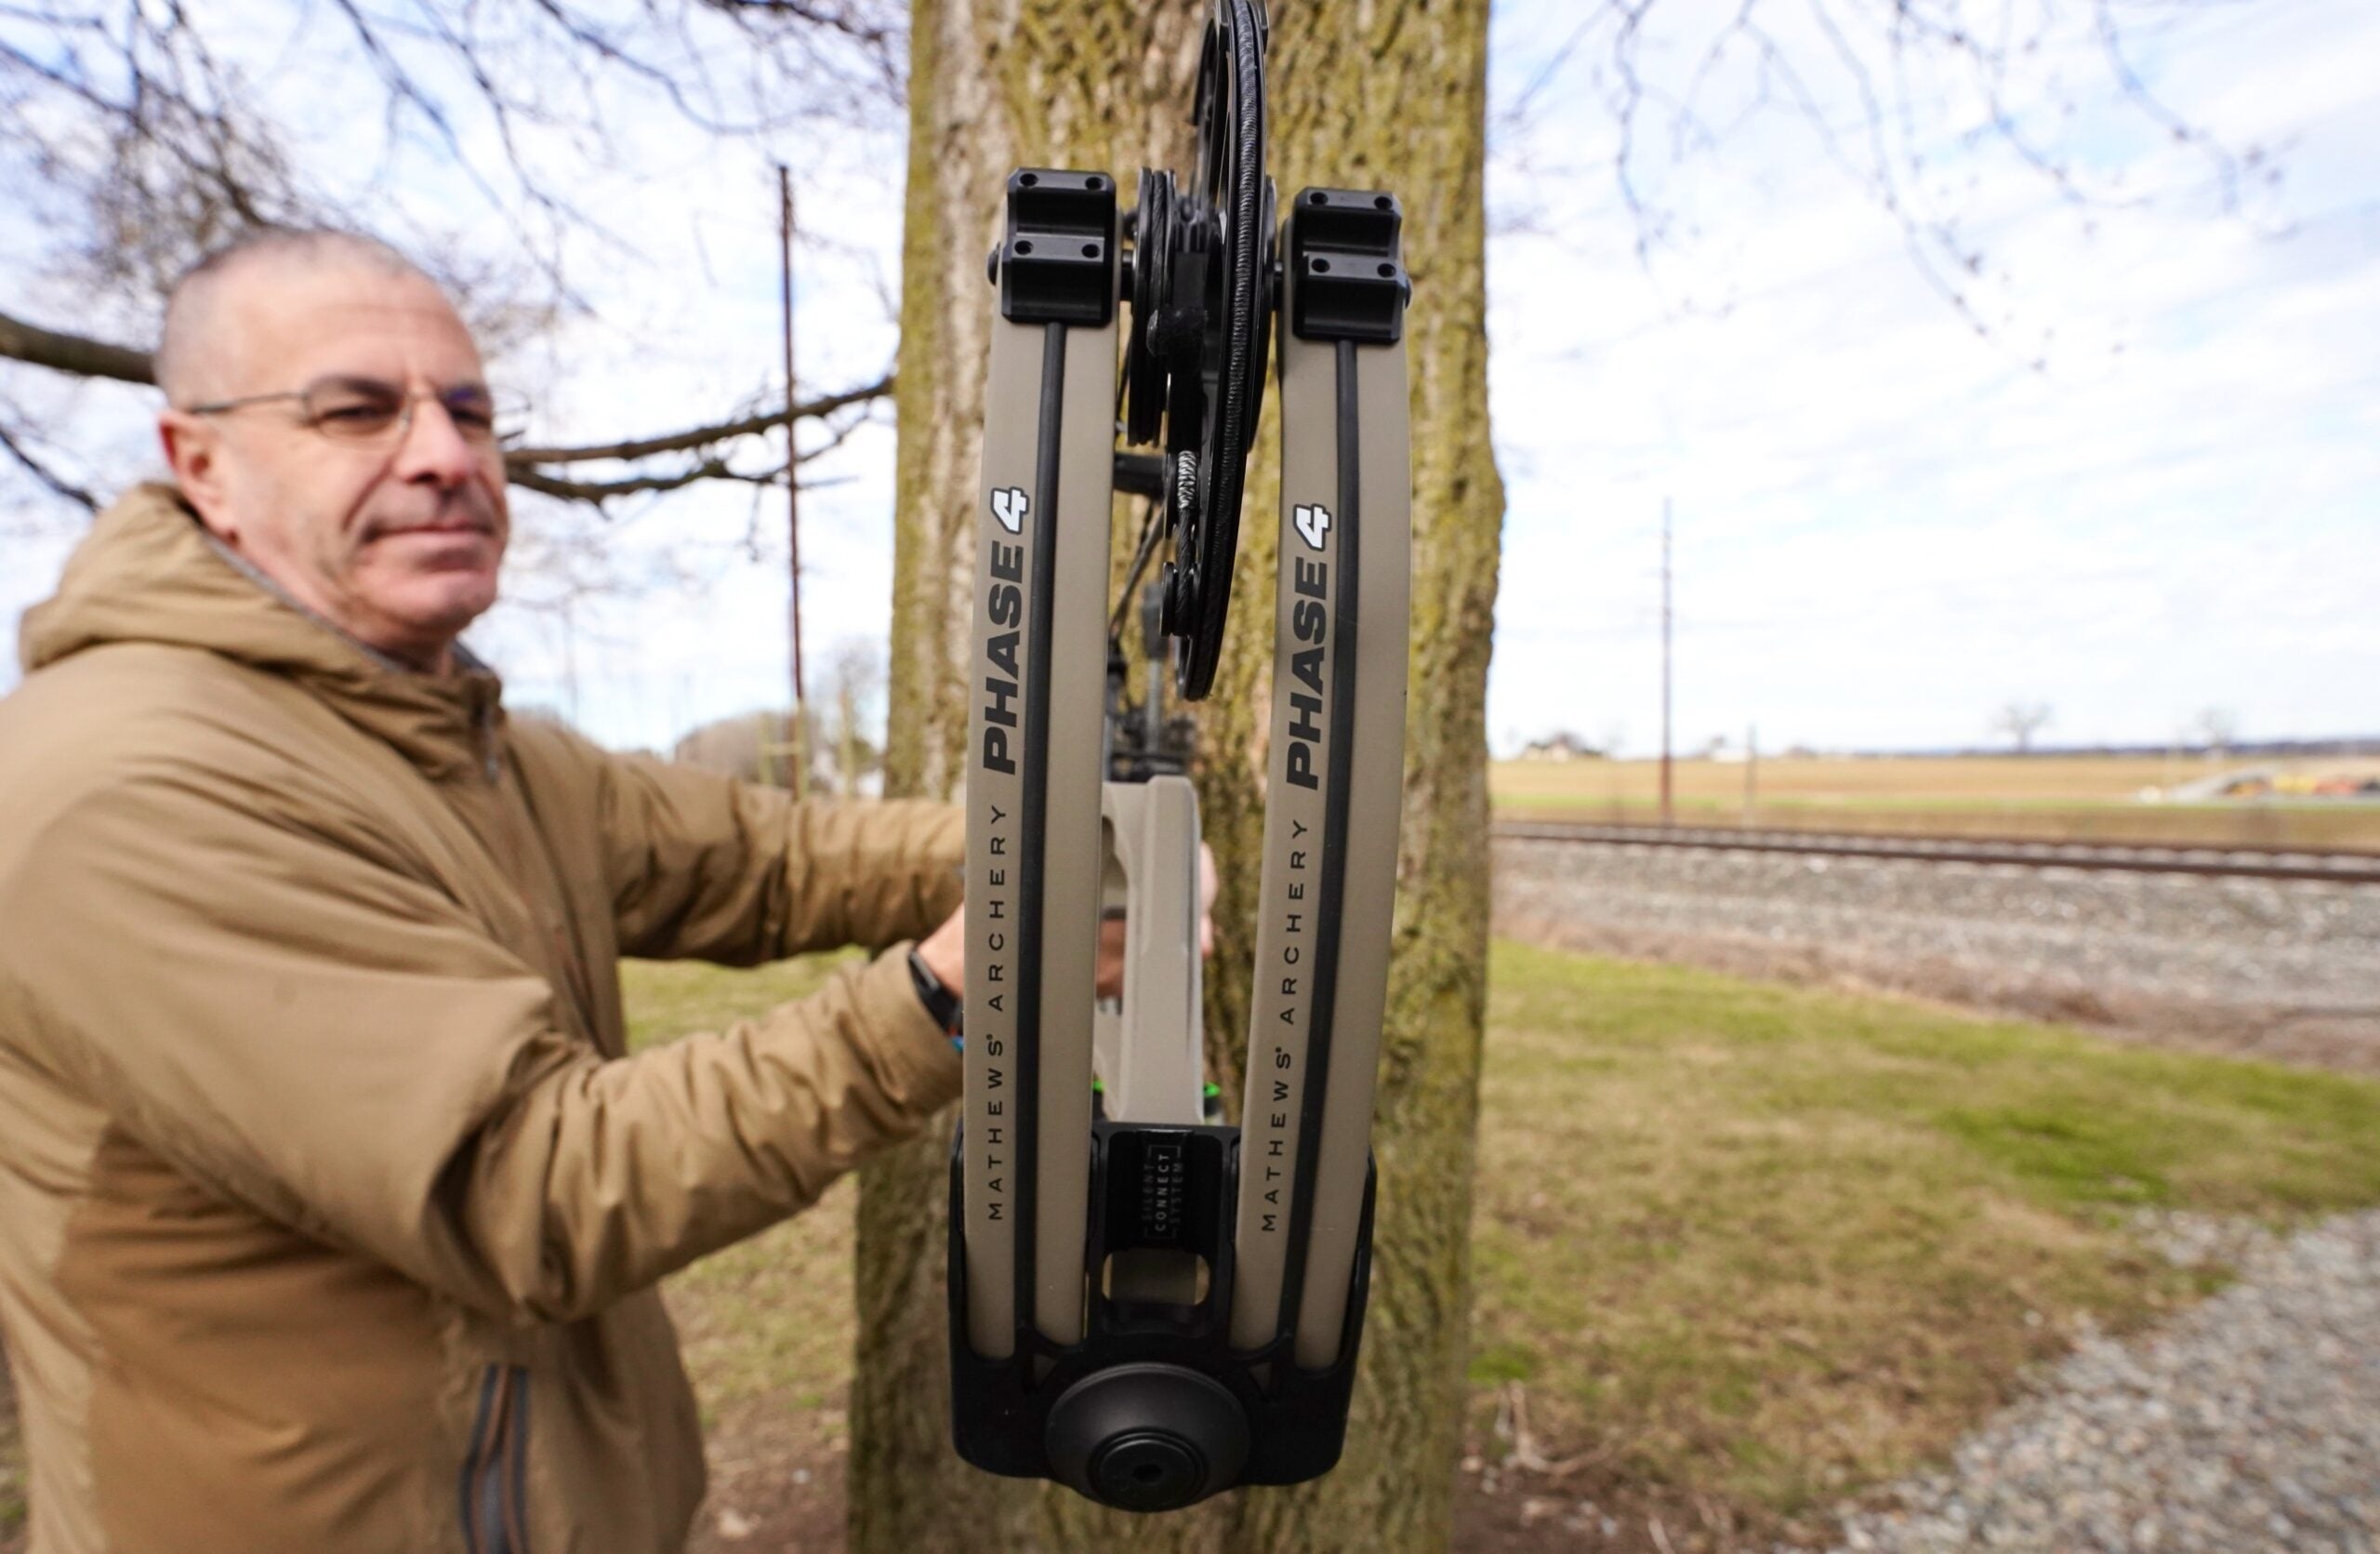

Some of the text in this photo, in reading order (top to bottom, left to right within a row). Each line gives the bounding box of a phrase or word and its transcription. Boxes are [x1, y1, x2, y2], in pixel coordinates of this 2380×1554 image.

[983, 486, 1030, 1220] MATHEWS ARCHERY PHASE 4
[1262, 502, 1332, 1231] MATHEWS ARCHERY PHASE 4
[1155, 1154, 1169, 1231] CONNECT
[1170, 1162, 1183, 1225] SYSTEM
